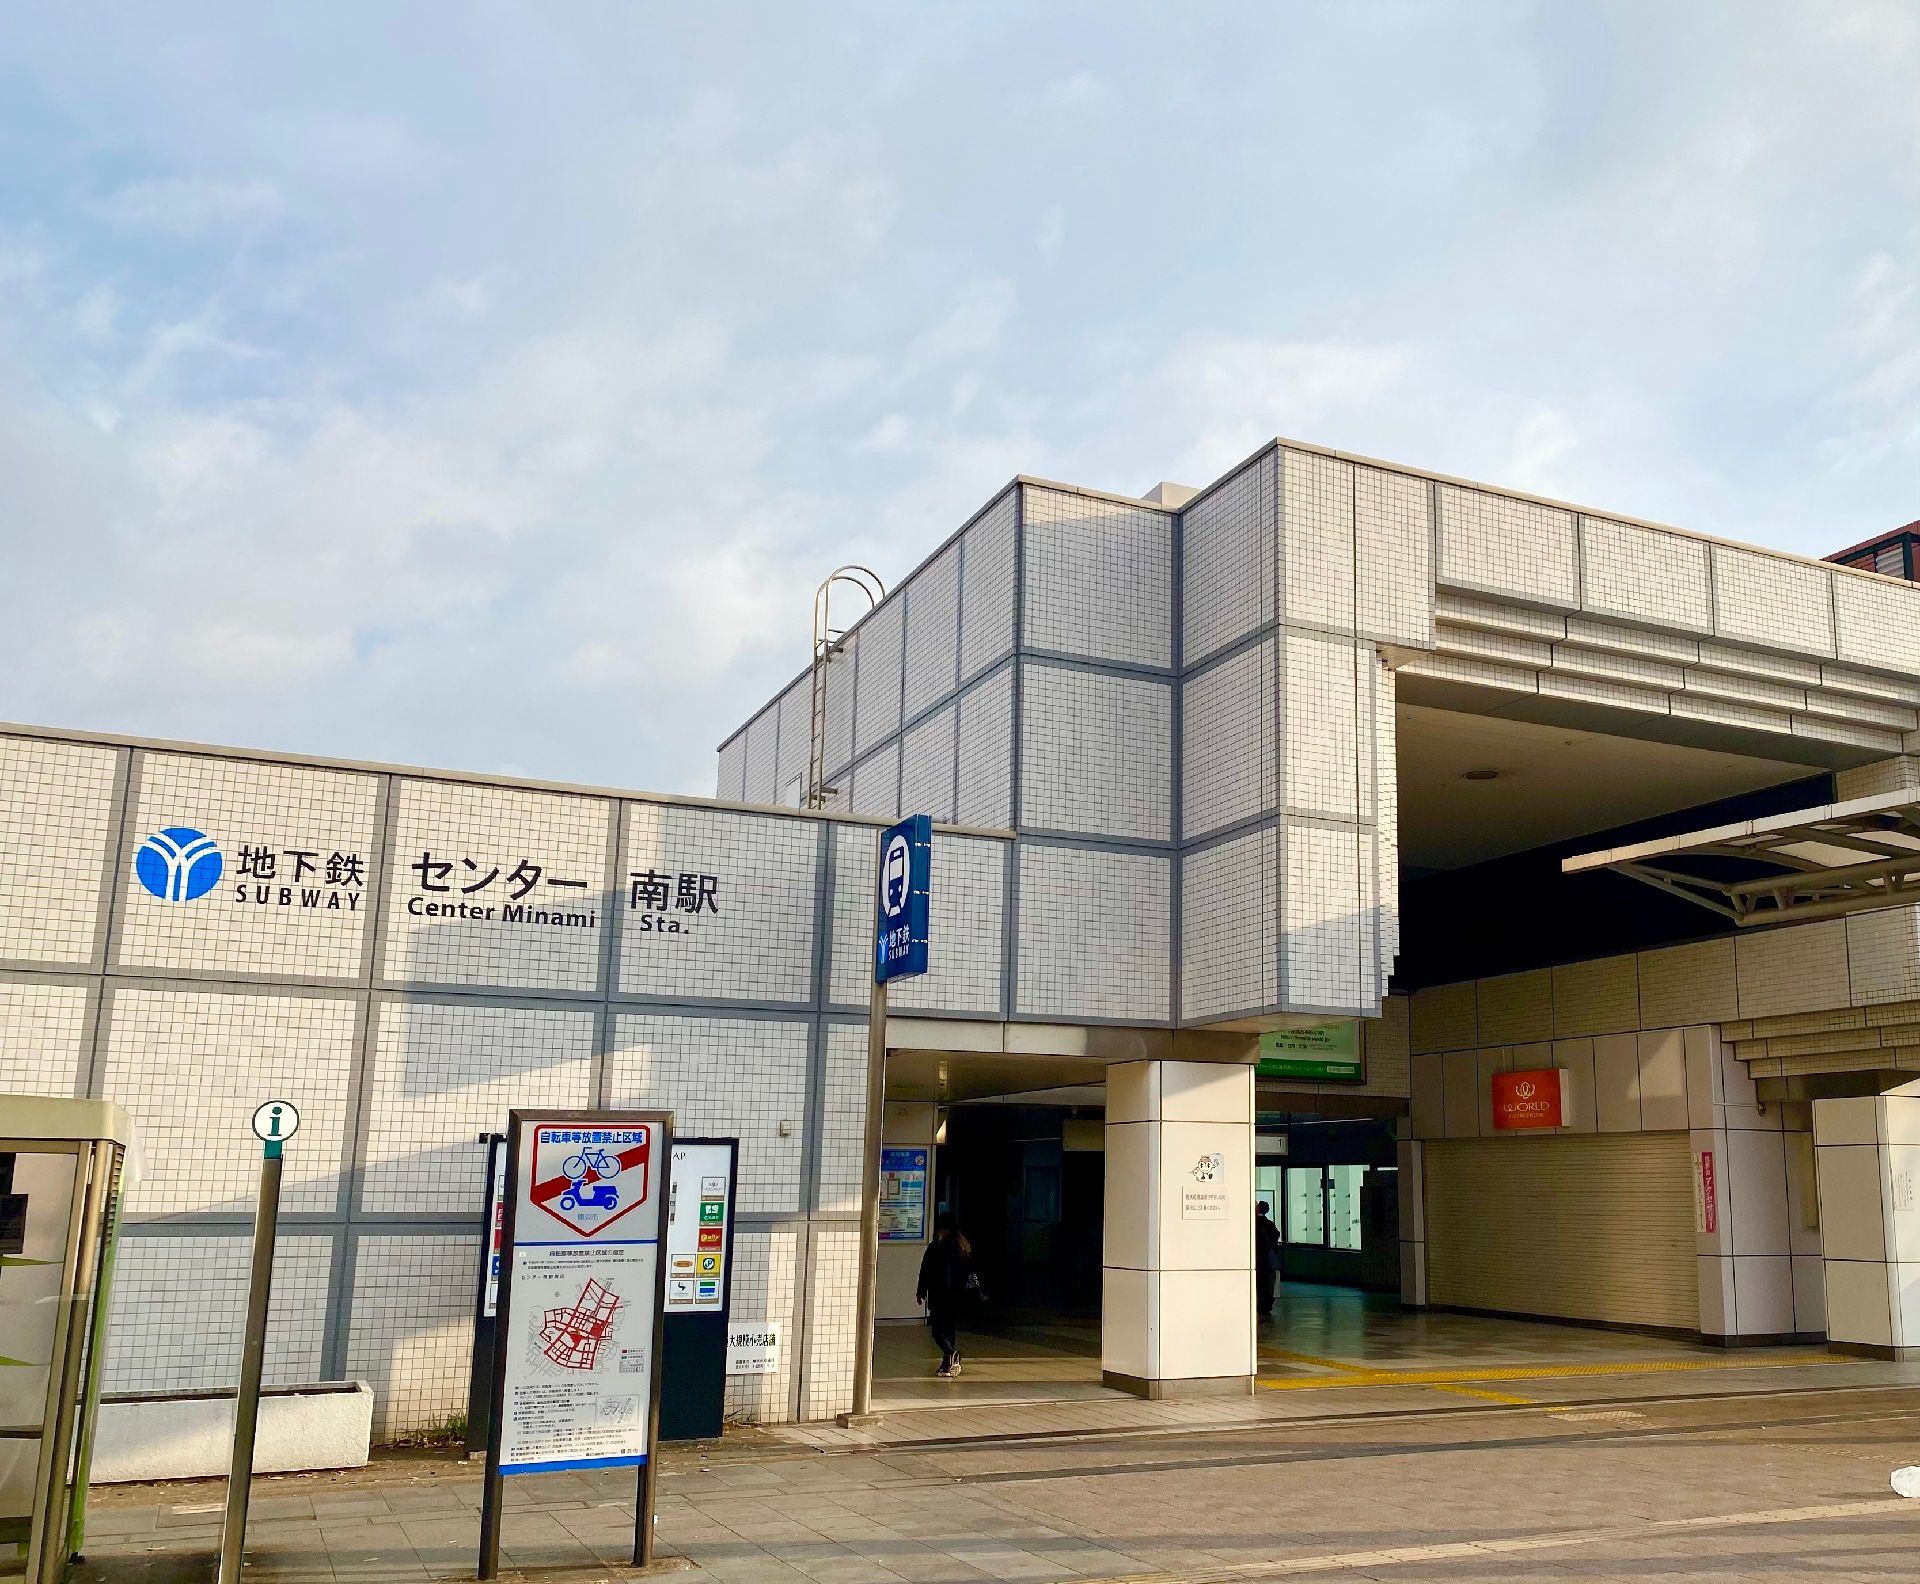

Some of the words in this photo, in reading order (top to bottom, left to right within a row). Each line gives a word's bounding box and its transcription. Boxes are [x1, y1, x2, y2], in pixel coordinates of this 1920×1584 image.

[236, 845, 365, 887] 地下鉄
[235, 885, 361, 911] SUBWAY
[407, 896, 495, 920] Center
[502, 903, 596, 928] Minami
[640, 913, 690, 934] Sta.
[888, 924, 910, 948] 地下鉄
[1503, 1101, 1550, 1112] WORLD
[540, 1131, 643, 1144] 自転車等放置禁止区域
[672, 1151, 686, 1161] AP
